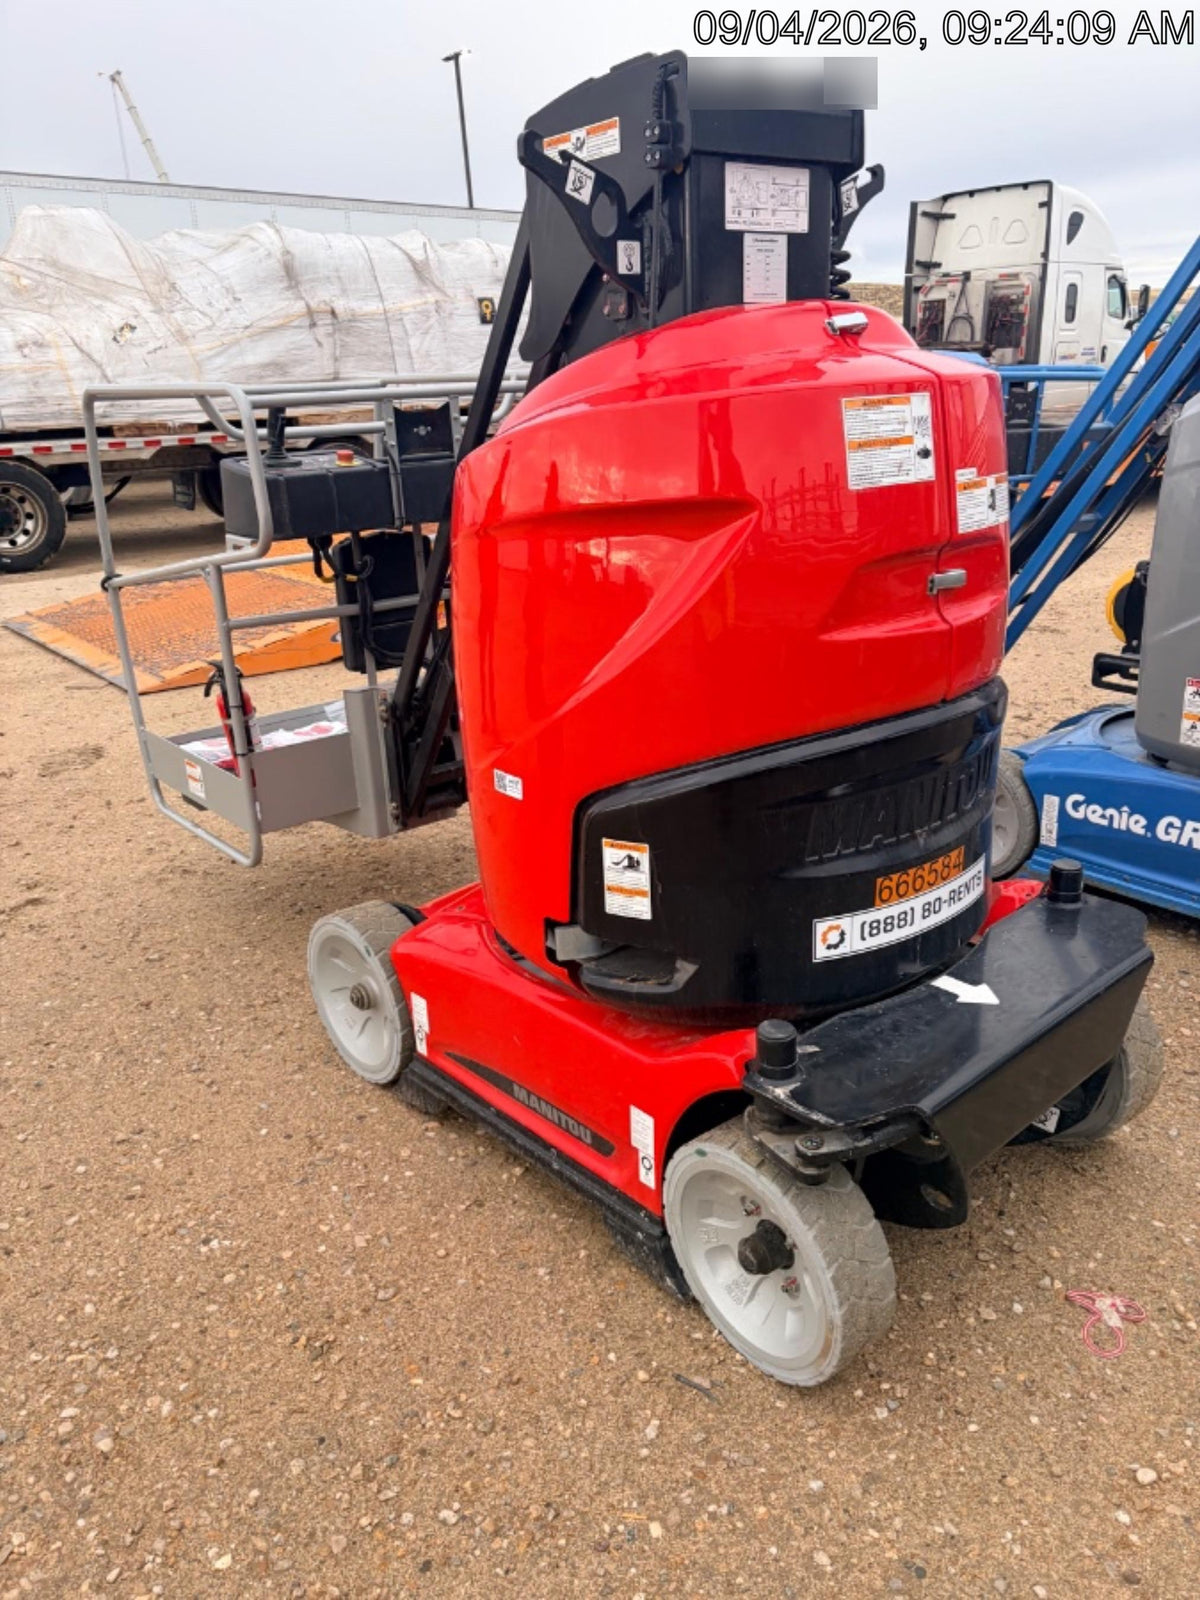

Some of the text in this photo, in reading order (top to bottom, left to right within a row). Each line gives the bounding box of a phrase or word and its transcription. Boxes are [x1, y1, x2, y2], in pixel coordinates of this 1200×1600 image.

[803, 742, 993, 862] MANITOU
[1065, 793, 1148, 836] Genie
[877, 850, 964, 904] 666584
[859, 906, 915, 941] (888)
[511, 1082, 592, 1145] MANITOU
